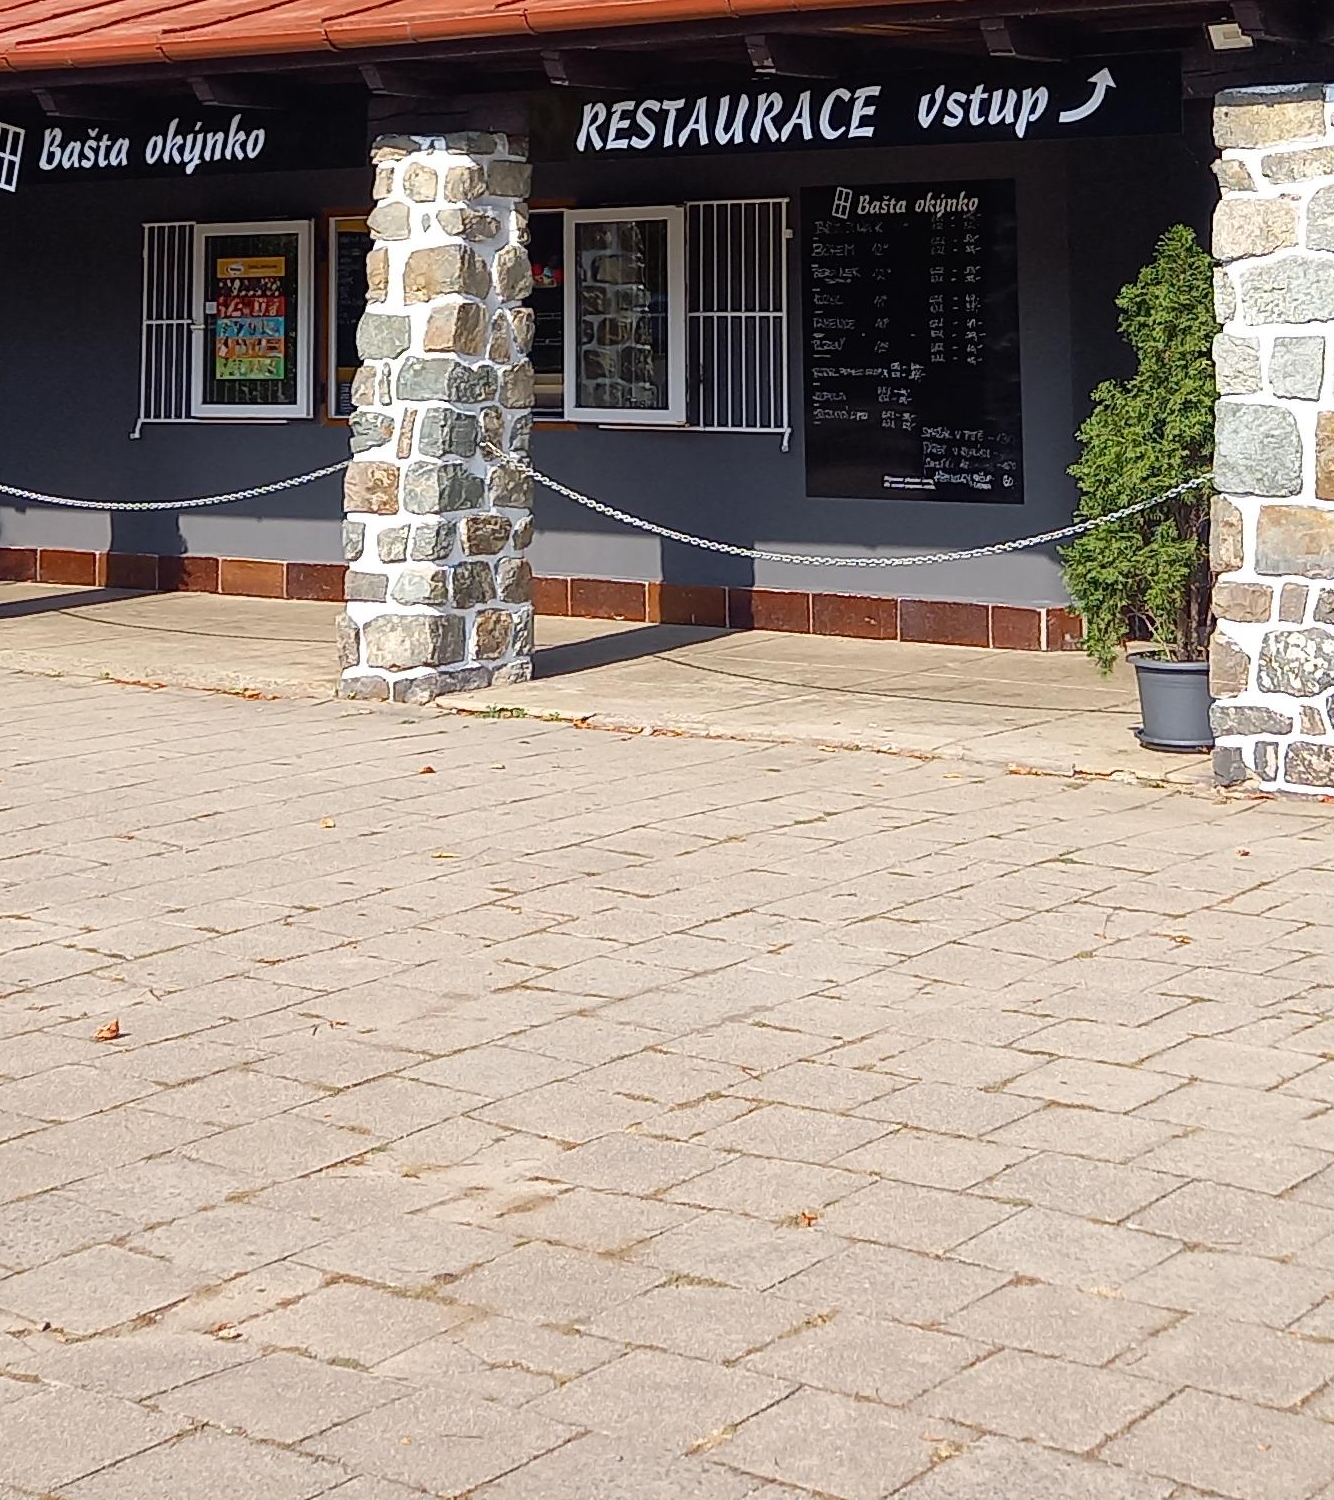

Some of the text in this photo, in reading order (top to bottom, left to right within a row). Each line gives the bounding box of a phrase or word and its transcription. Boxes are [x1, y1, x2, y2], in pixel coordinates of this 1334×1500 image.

[38, 114, 266, 175] Bašta okýnko
[576, 83, 1049, 152] RESTAURACE vstup
[856, 190, 979, 218] Bašta okýnko
